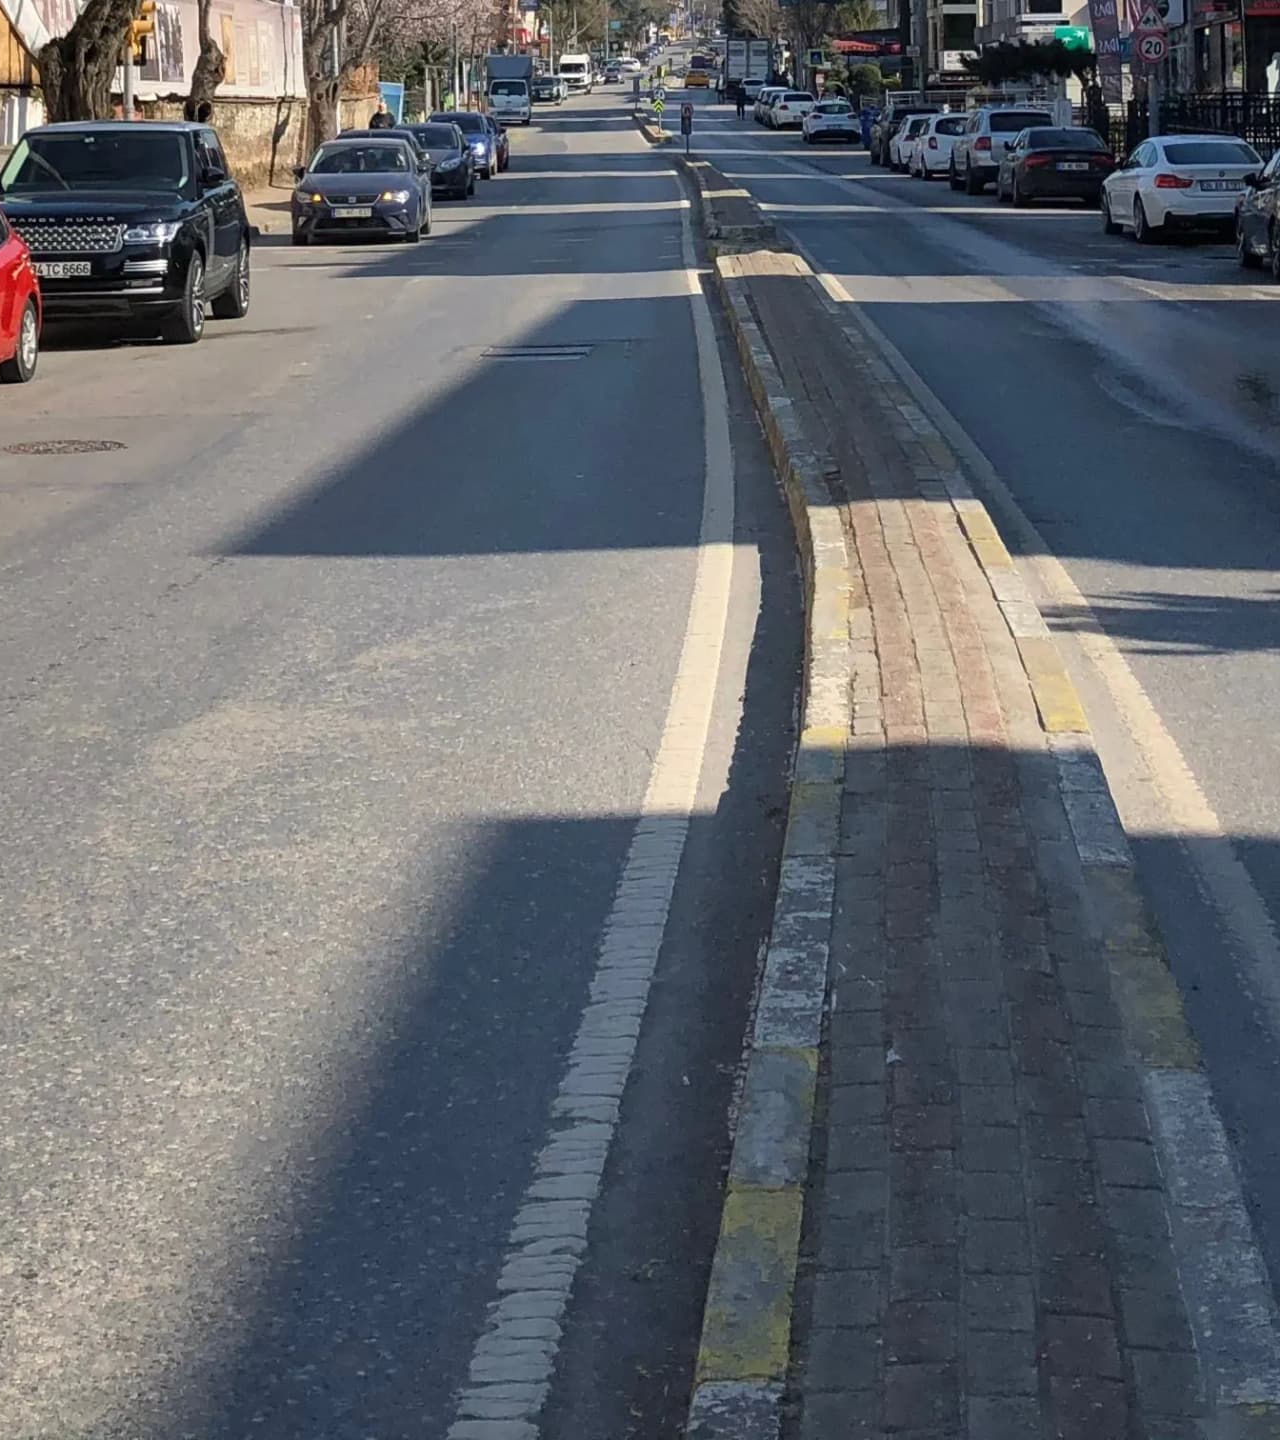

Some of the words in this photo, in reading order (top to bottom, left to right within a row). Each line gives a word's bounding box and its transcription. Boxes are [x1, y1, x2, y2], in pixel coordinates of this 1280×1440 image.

[1145, 40, 1162, 55] 20
[46, 263, 60, 274] TC
[62, 263, 90, 274] 6666
